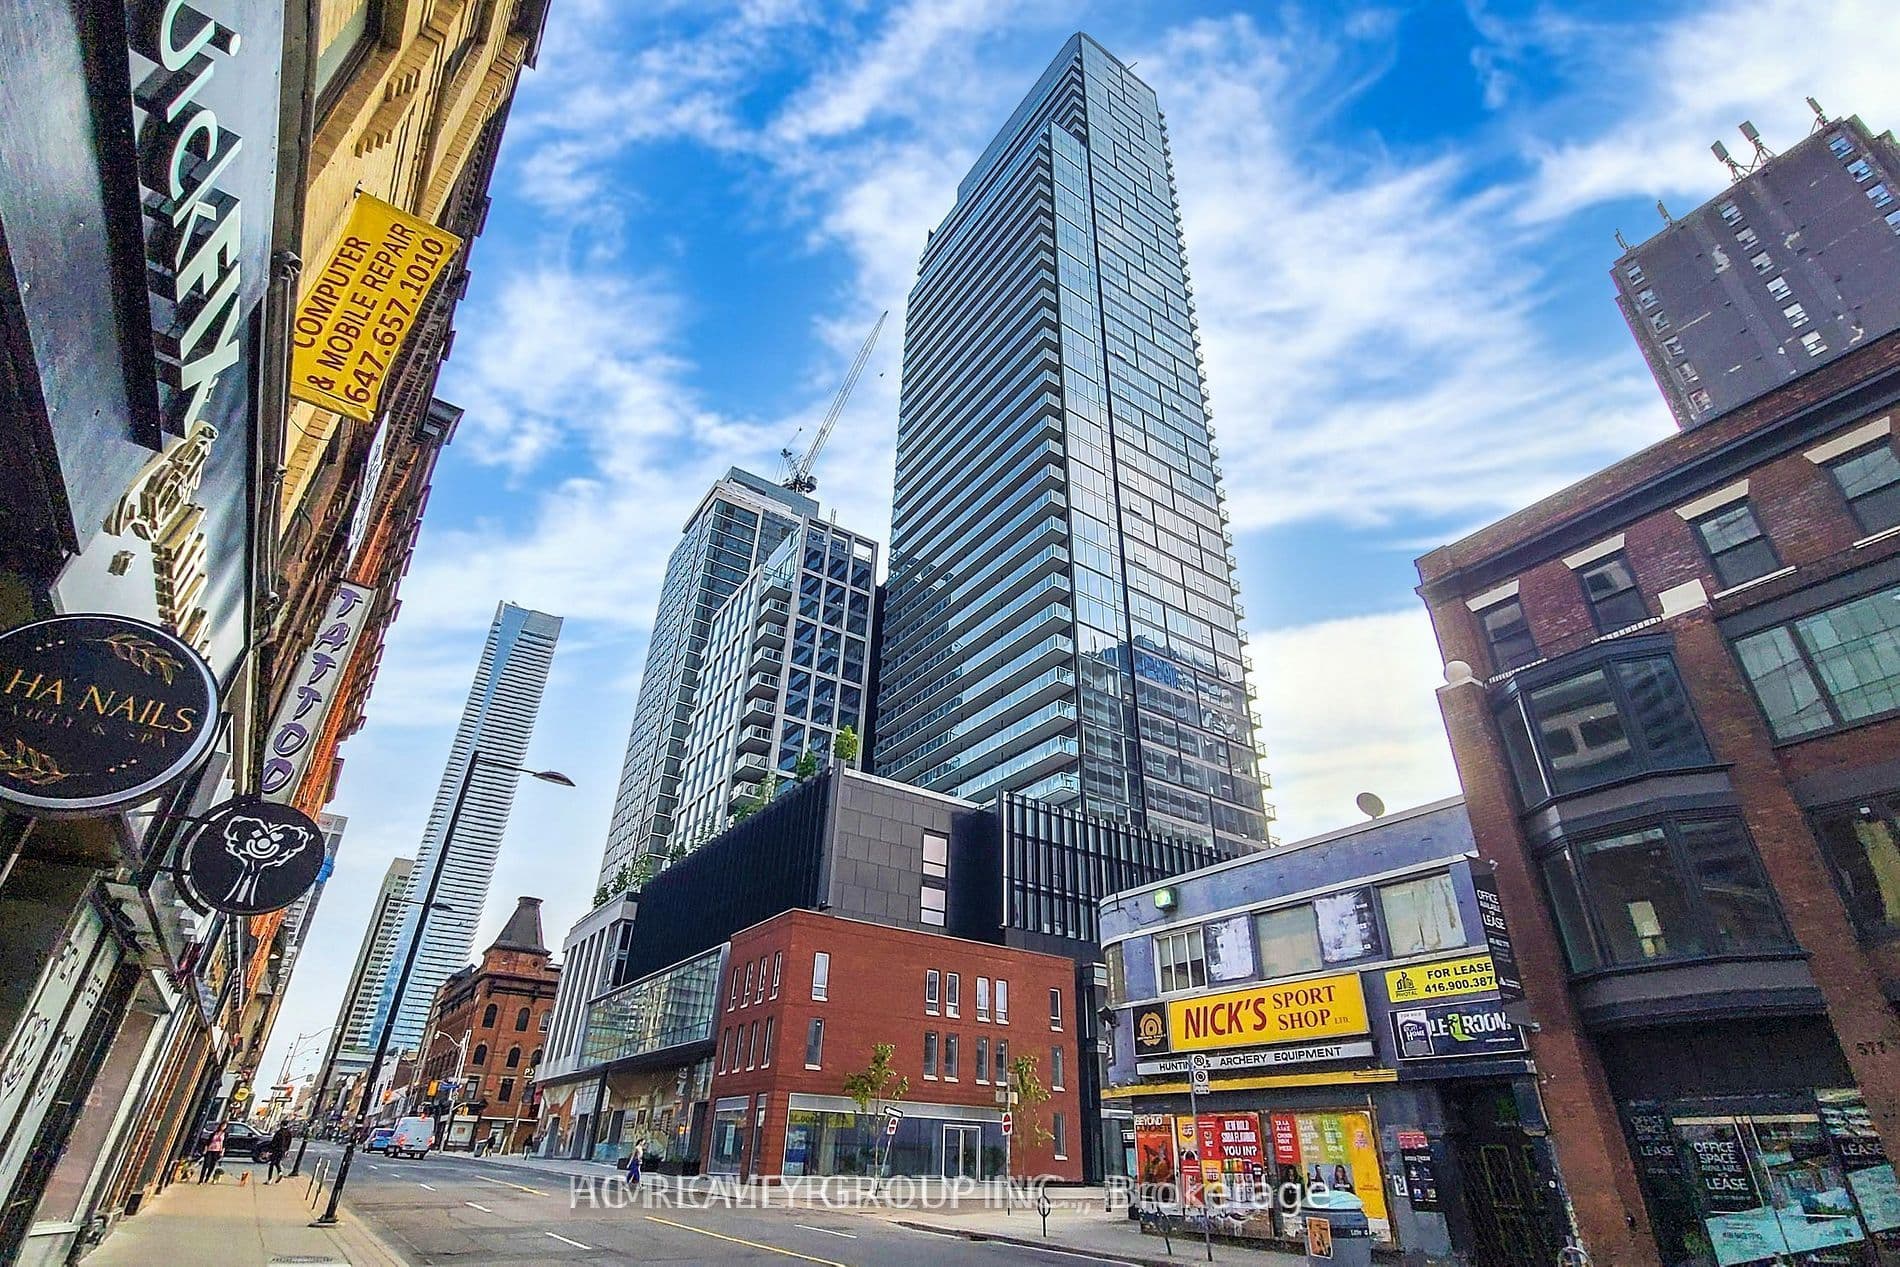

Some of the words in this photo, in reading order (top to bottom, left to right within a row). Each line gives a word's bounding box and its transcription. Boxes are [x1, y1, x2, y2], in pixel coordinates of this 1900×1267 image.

[359, 222, 417, 293] REPAIR
[294, 235, 371, 349] COMPUTER
[343, 237, 445, 404] 647.657.1010
[315, 291, 378, 373] MOBILE
[306, 374, 337, 391] &
[261, 586, 363, 794] TATTOO
[77, 684, 198, 734] NAILS
[1476, 888, 1500, 905] OFFICE
[1482, 912, 1507, 930] LEASE
[1426, 967, 1451, 980] FOR
[1453, 962, 1493, 976] LEASE
[1272, 984, 1336, 1010] SPORT
[1184, 997, 1268, 1040] NICK'S
[1277, 1008, 1331, 1031] SHOP
[1219, 1053, 1267, 1066] ARCHERY
[1274, 1046, 1342, 1062] EQUIPMENT
[1135, 1116, 1163, 1126] BEYOND
[1223, 1146, 1241, 1156] YOU
[1242, 1145, 1257, 1156] IN?
[1640, 1145, 1675, 1157] LEASE
[1693, 1141, 1737, 1153] OFFICE
[1840, 1141, 1885, 1156] LEASE
[1700, 1153, 1738, 1164] SPACE
[1705, 1177, 1749, 1191] LEASE
